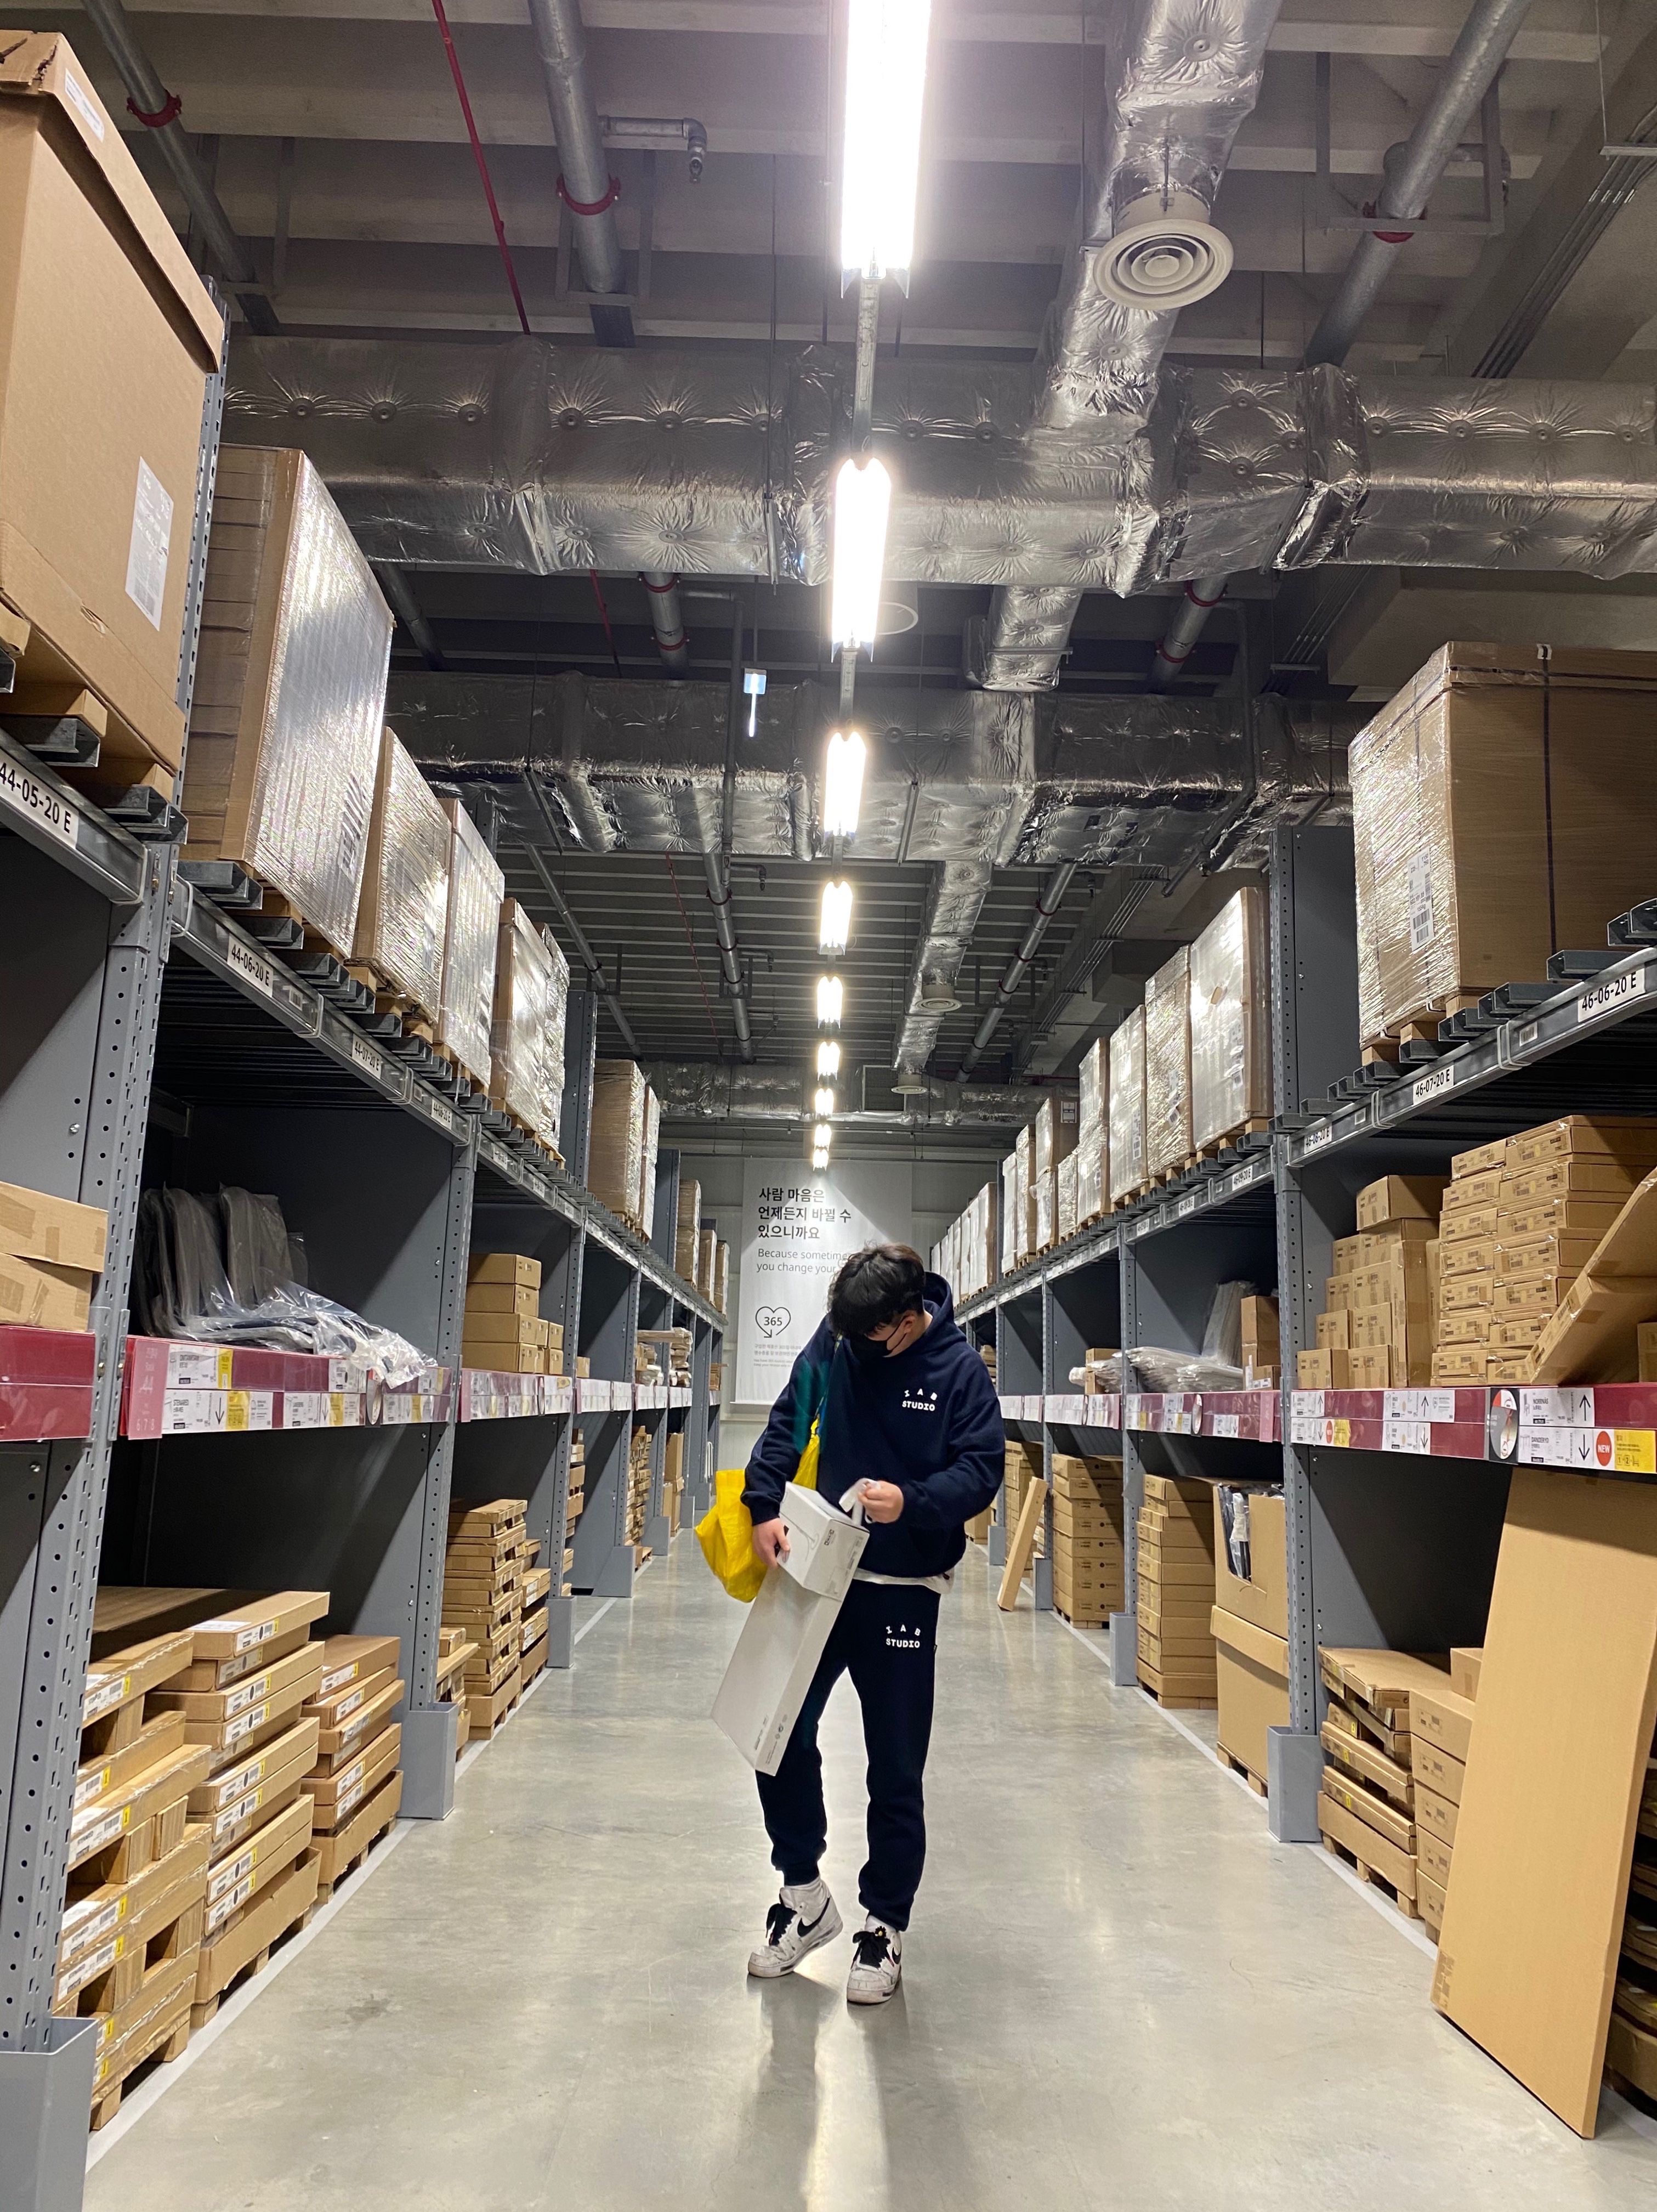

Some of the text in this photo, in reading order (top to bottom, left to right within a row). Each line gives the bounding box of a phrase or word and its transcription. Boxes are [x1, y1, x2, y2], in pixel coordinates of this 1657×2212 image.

[0, 762, 71, 834] 44-05-20 E
[232, 944, 269, 987] 44-06-20 E
[1582, 971, 1636, 1011] 46-06-20 E
[355, 1041, 376, 1068] 44-07-20
[1416, 1068, 1450, 1097] 46-07-20 E
[759, 1187, 825, 1202] 사람 마음은
[758, 1206, 852, 1223] 언제든지 바뀔 수
[758, 1225, 820, 1240] 있으니까요
[758, 1248, 798, 1258] Because
[757, 1263, 836, 1274] you change your
[764, 1316, 782, 1326] 365
[902, 1400, 935, 1412] STUDIO
[1597, 1444, 1610, 1453] NEW
[886, 1638, 920, 1648] STUDIO
